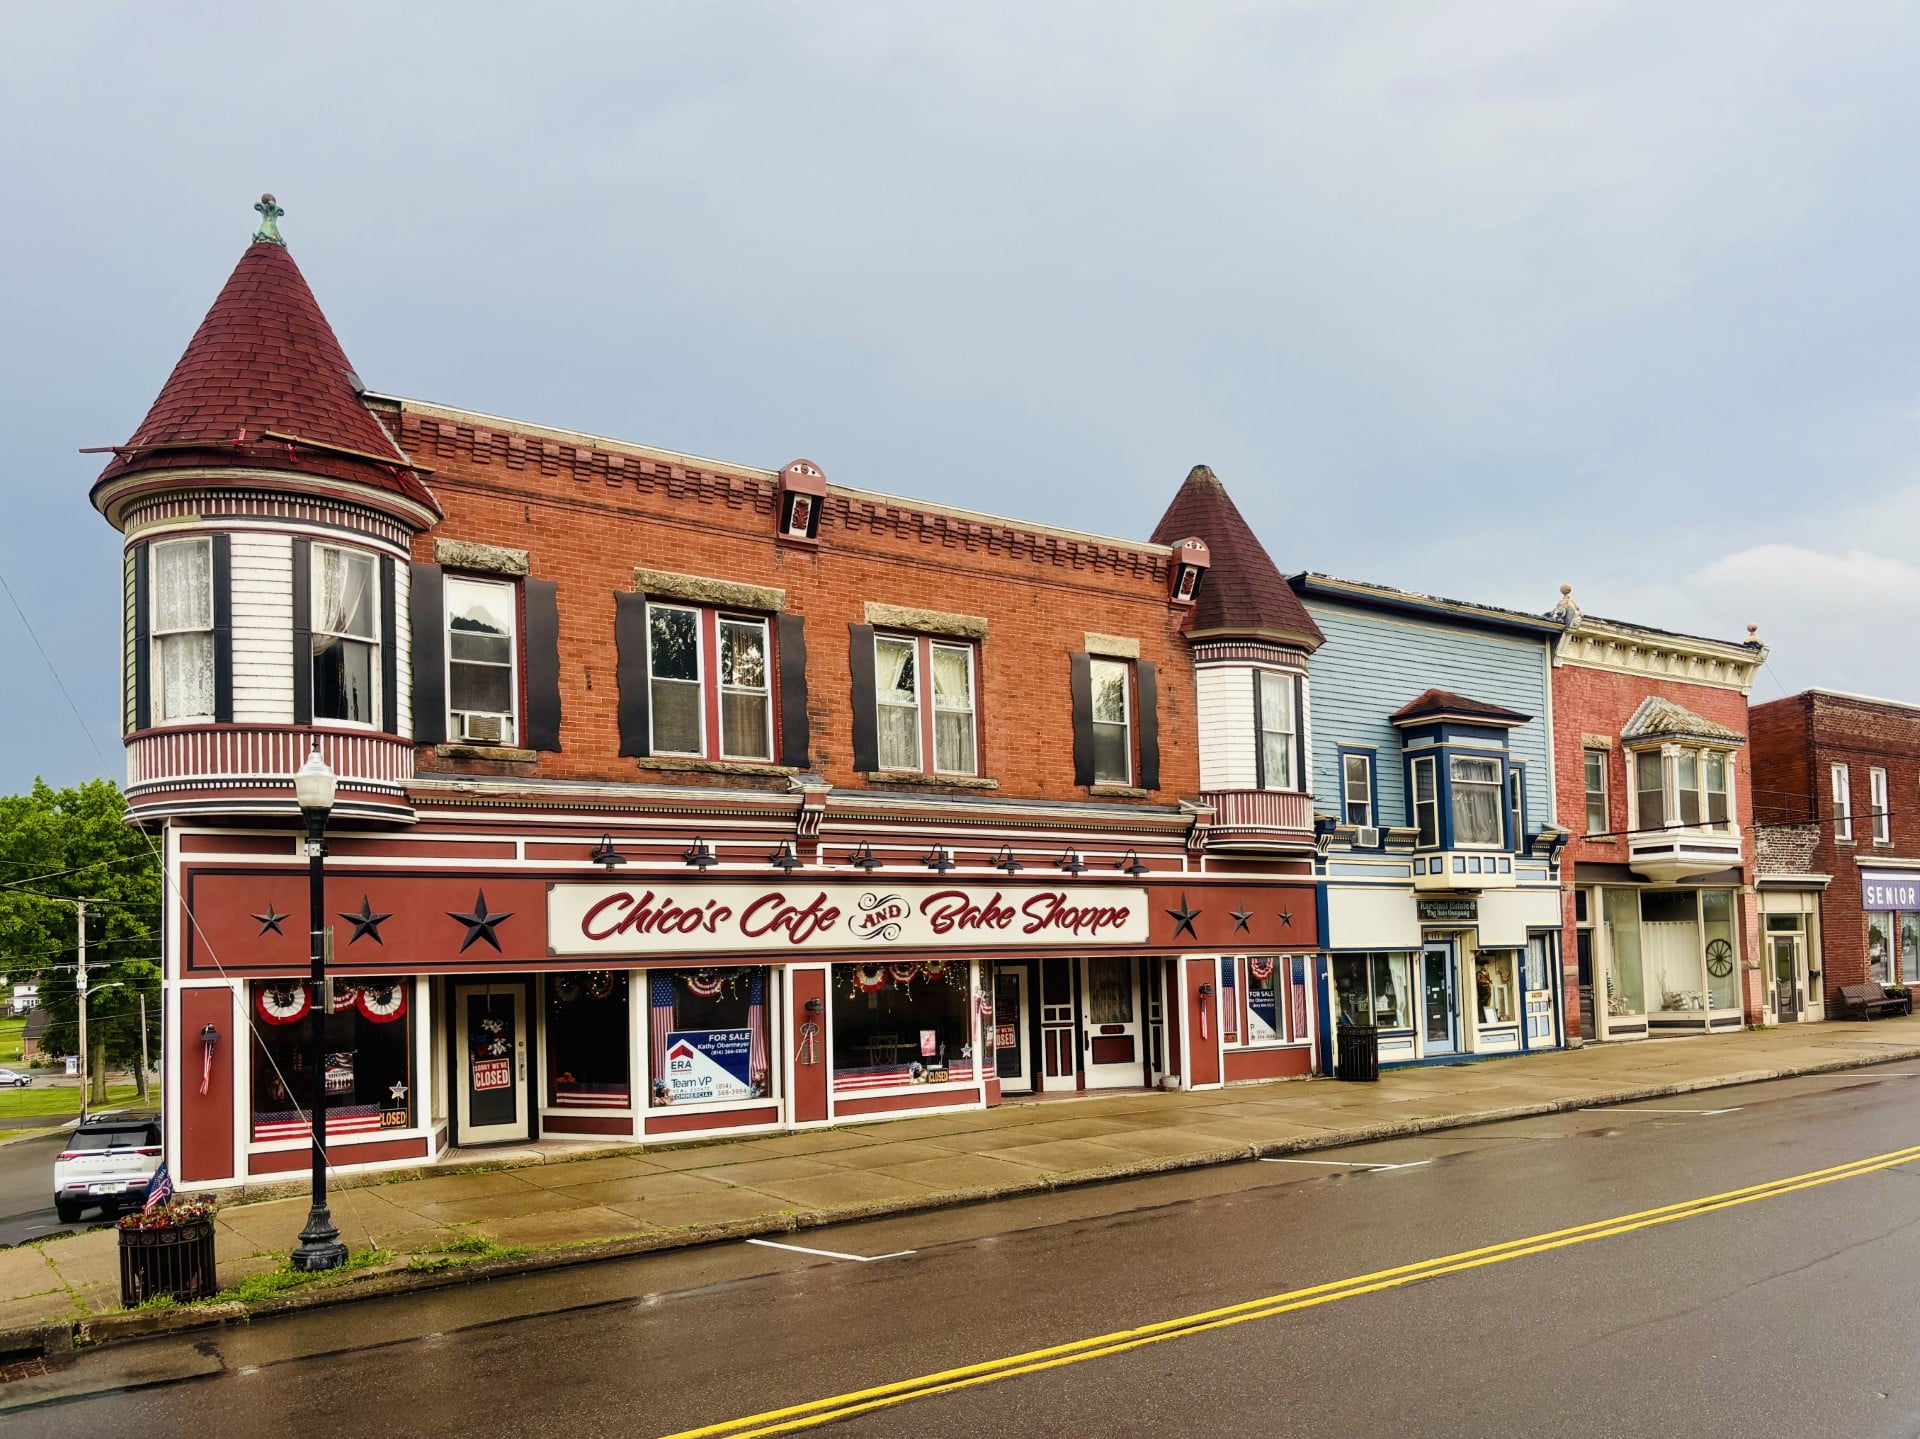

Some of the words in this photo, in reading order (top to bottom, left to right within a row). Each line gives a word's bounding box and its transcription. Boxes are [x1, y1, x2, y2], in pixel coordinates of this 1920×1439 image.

[1867, 886, 1915, 904] SENIOR
[581, 890, 732, 941] Chico's
[739, 891, 840, 944] Cafe
[859, 904, 901, 928] AND
[919, 890, 1016, 934] Bake
[1022, 892, 1130, 936] Shoppe
[729, 1033, 750, 1041] SALE
[997, 1033, 1013, 1046] OSED
[671, 1061, 692, 1069] ERA
[475, 1069, 508, 1087] CLOSED
[671, 1078, 696, 1088] Team
[698, 1076, 712, 1086] VP
[930, 1071, 948, 1082] CLOSED
